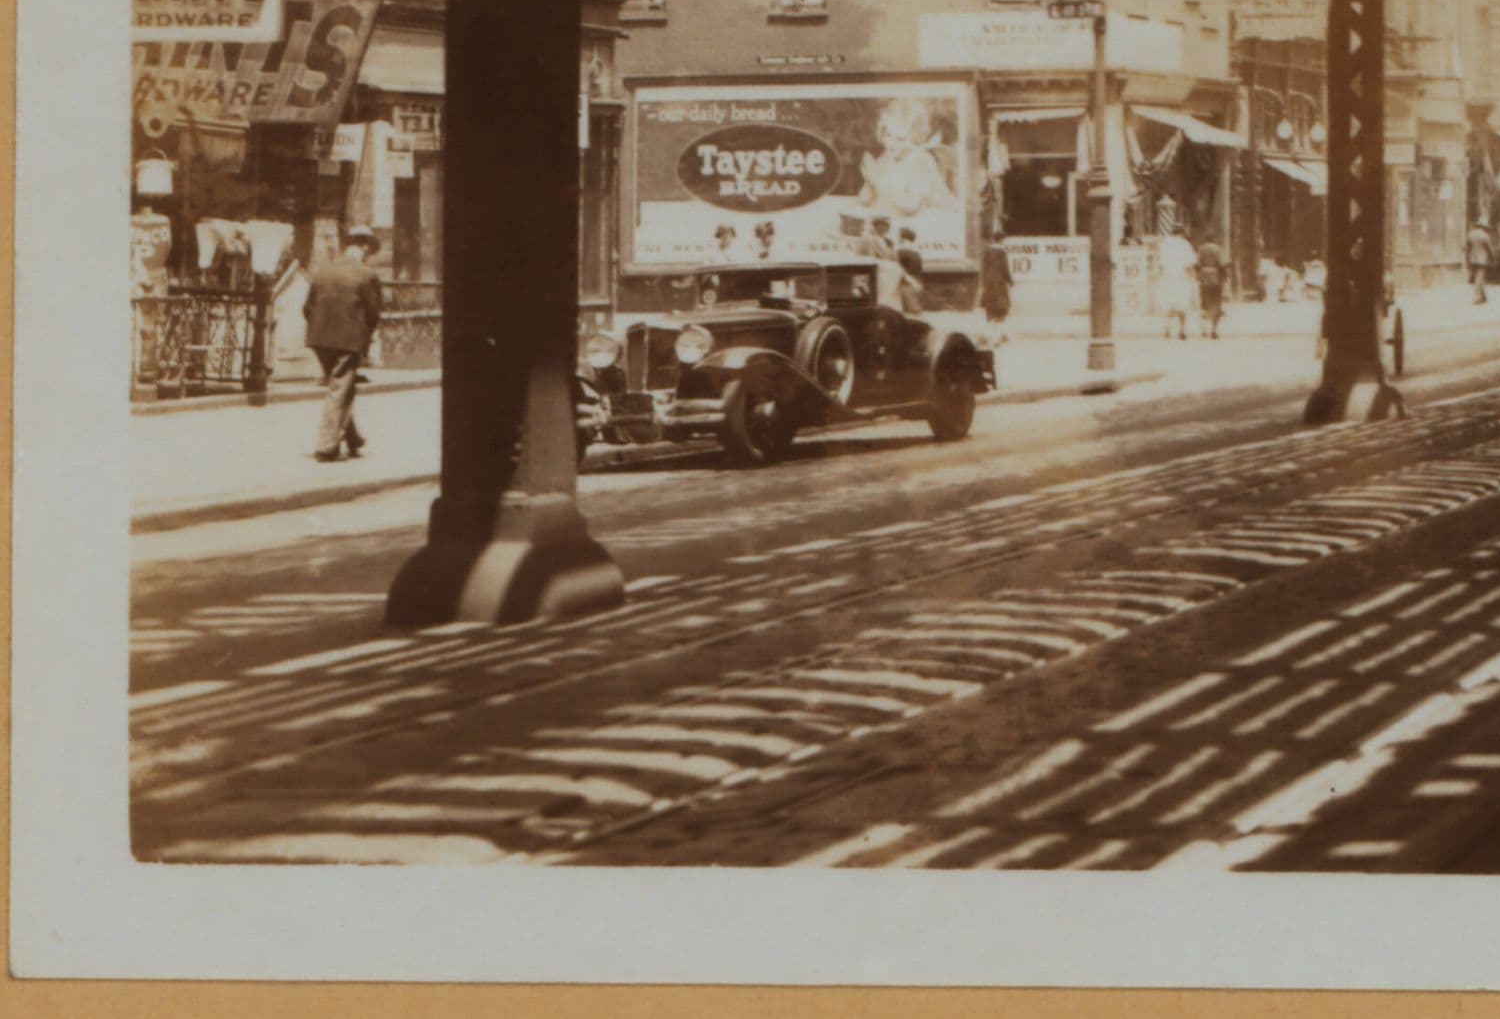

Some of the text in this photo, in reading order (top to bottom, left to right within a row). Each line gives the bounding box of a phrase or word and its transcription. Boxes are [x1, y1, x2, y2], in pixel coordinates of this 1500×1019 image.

[731, 102, 777, 121] bread
[697, 143, 826, 182] Taystee
[719, 180, 801, 200] BREAD
[1012, 256, 1078, 274] 10 15
